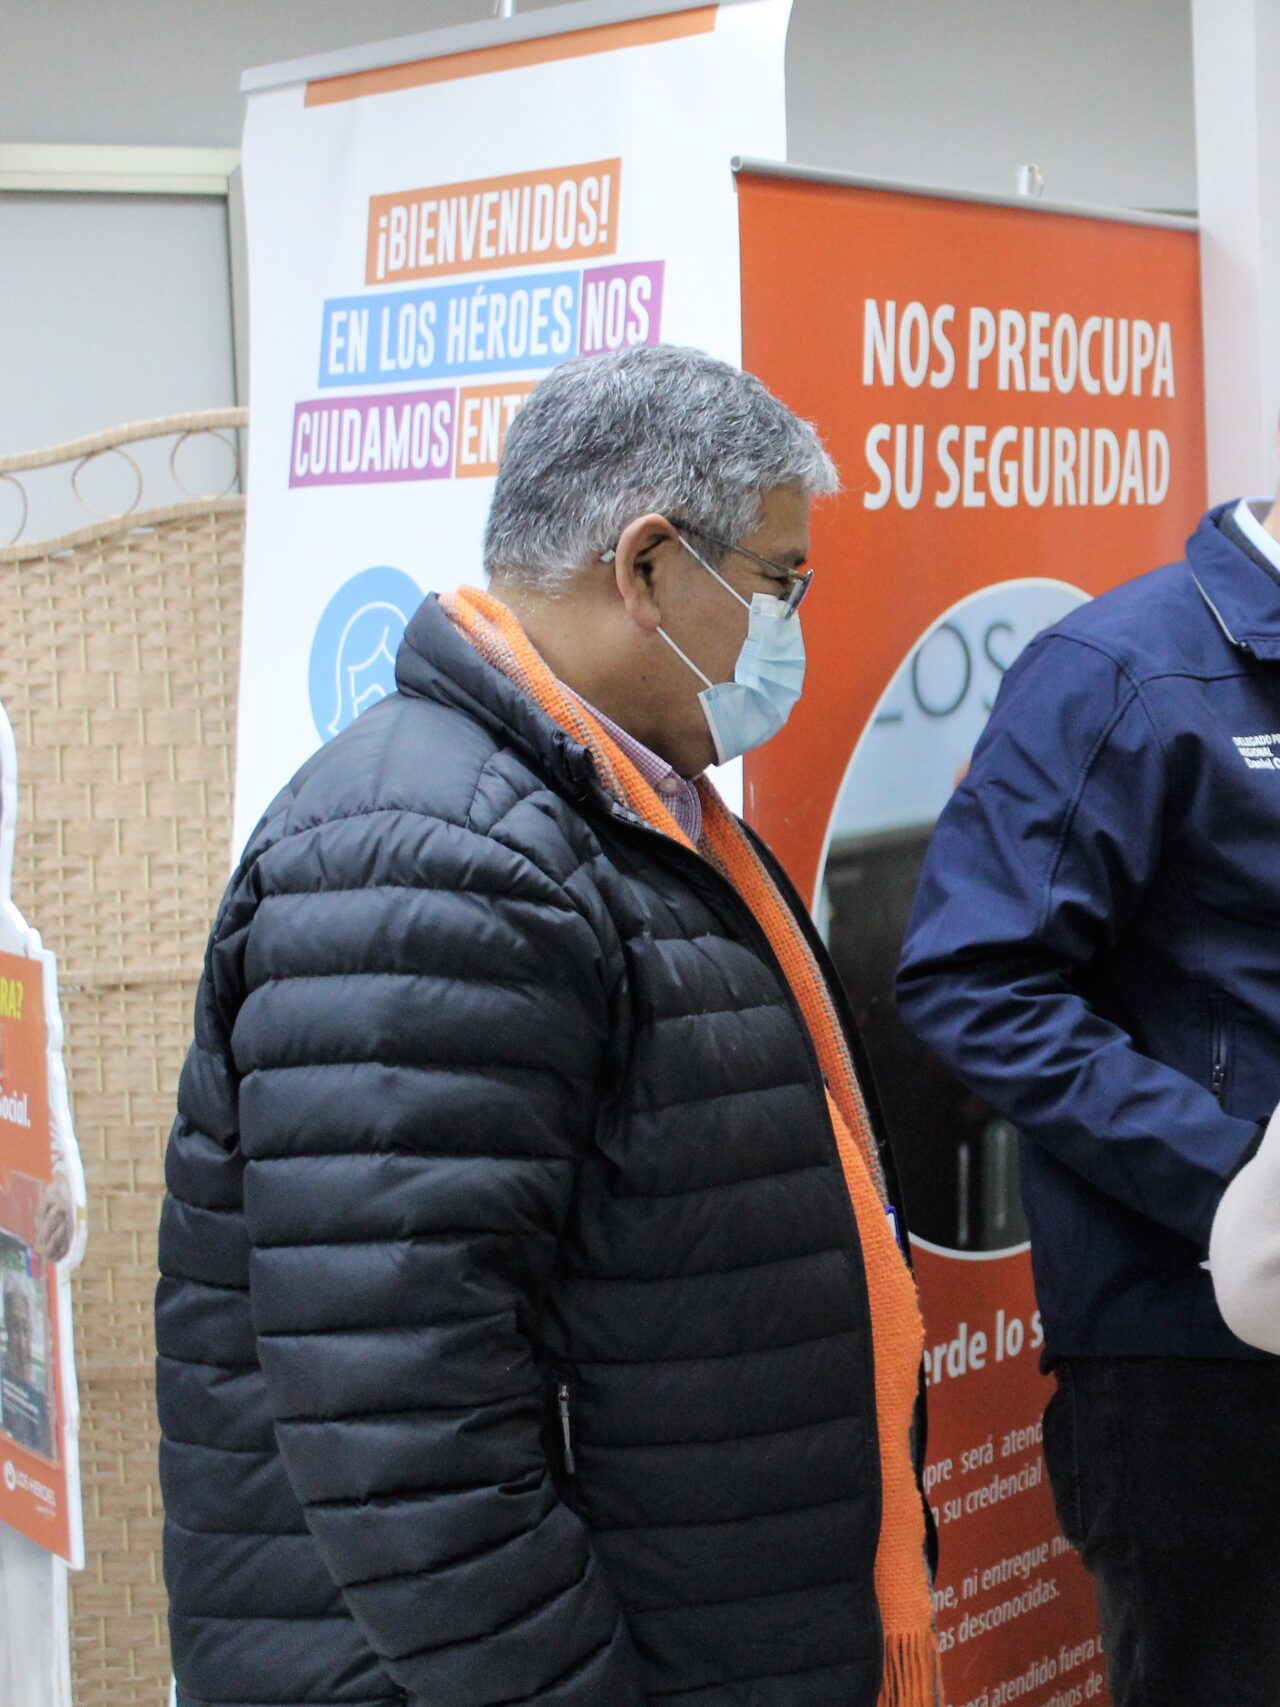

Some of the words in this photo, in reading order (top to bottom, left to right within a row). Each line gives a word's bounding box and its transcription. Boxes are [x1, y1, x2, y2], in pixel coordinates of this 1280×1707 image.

[376, 174, 612, 279] ¡BIENVENIDOS!
[327, 308, 368, 375] EN
[380, 299, 436, 370] LOS
[447, 283, 574, 365] HÉROES
[584, 274, 652, 351] NOS
[862, 298, 955, 389] NOS
[967, 306, 1175, 398] PREOCUPA
[294, 400, 452, 476] CUIDAMOS
[461, 393, 529, 466] ENT
[863, 423, 924, 510] SU
[936, 424, 1171, 508] SEGURIDAD
[874, 621, 1013, 724] OS
[995, 1309, 1025, 1362] lo
[923, 1458, 952, 1495] pre
[960, 1434, 994, 1474] será
[944, 1497, 961, 1524] su
[965, 1456, 1042, 1514] credencial
[963, 1567, 978, 1599] ni
[982, 1542, 1049, 1590] entregue
[958, 1578, 1060, 1643] desconocidas.
[991, 1657, 1057, 1707] atendido
[1059, 1638, 1095, 1674] fuera
[1084, 1671, 1103, 1699] de
